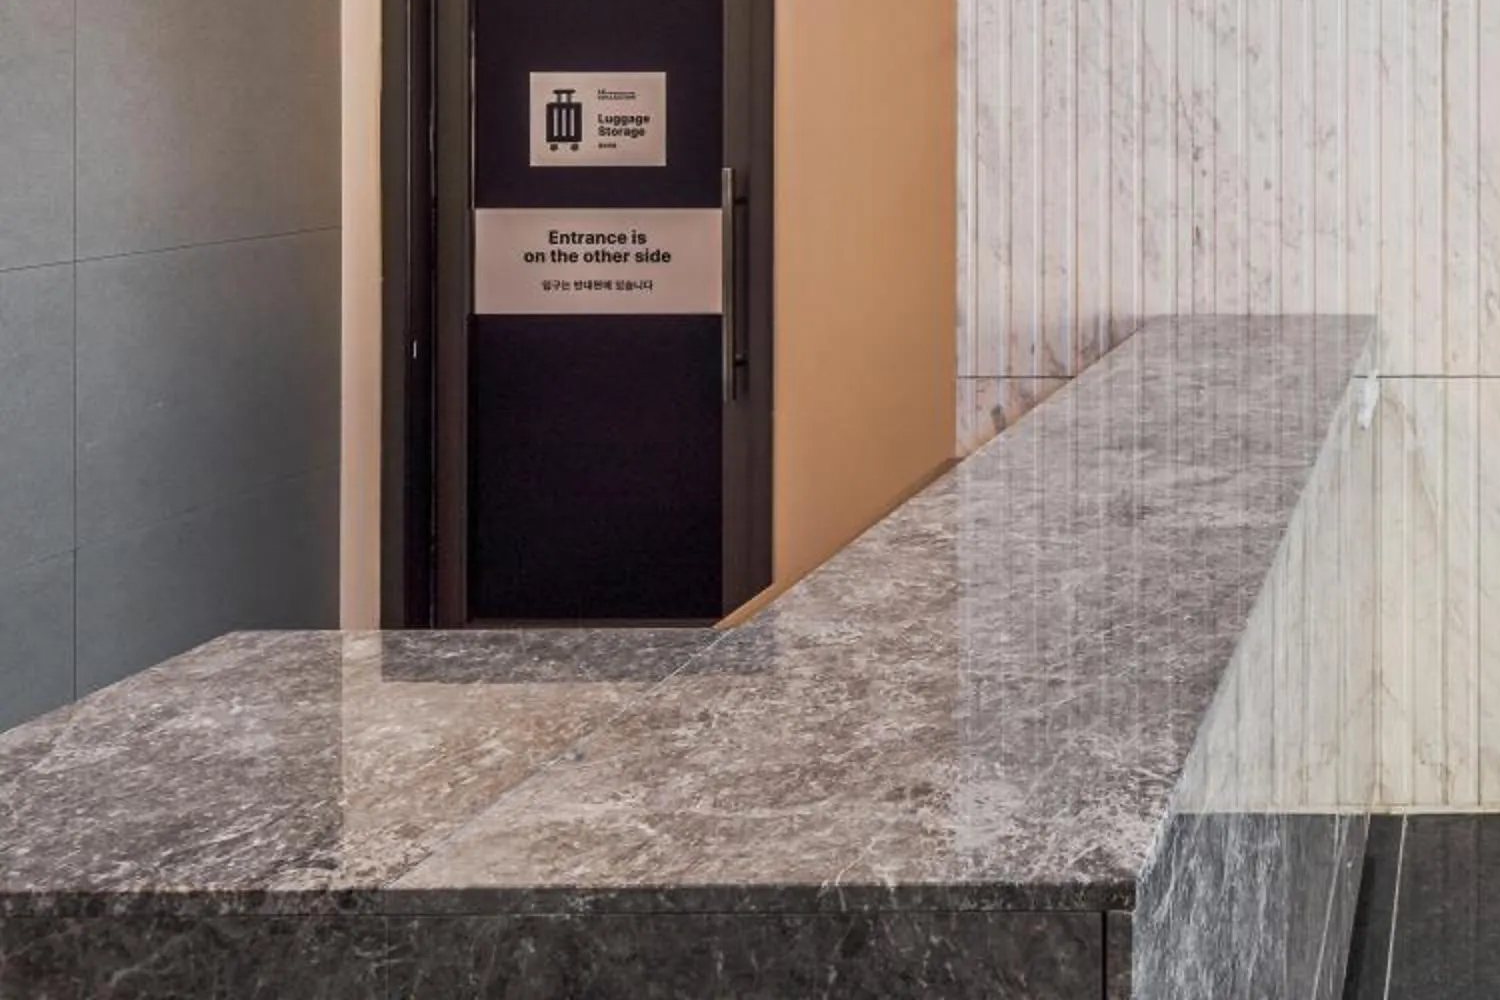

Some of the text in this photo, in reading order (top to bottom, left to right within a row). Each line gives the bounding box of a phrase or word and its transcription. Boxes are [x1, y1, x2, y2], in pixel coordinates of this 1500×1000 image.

[598, 113, 650, 126] Luggage
[598, 126, 646, 138] Storage
[549, 229, 648, 244] Entrance is
[523, 248, 671, 263] on the other side
